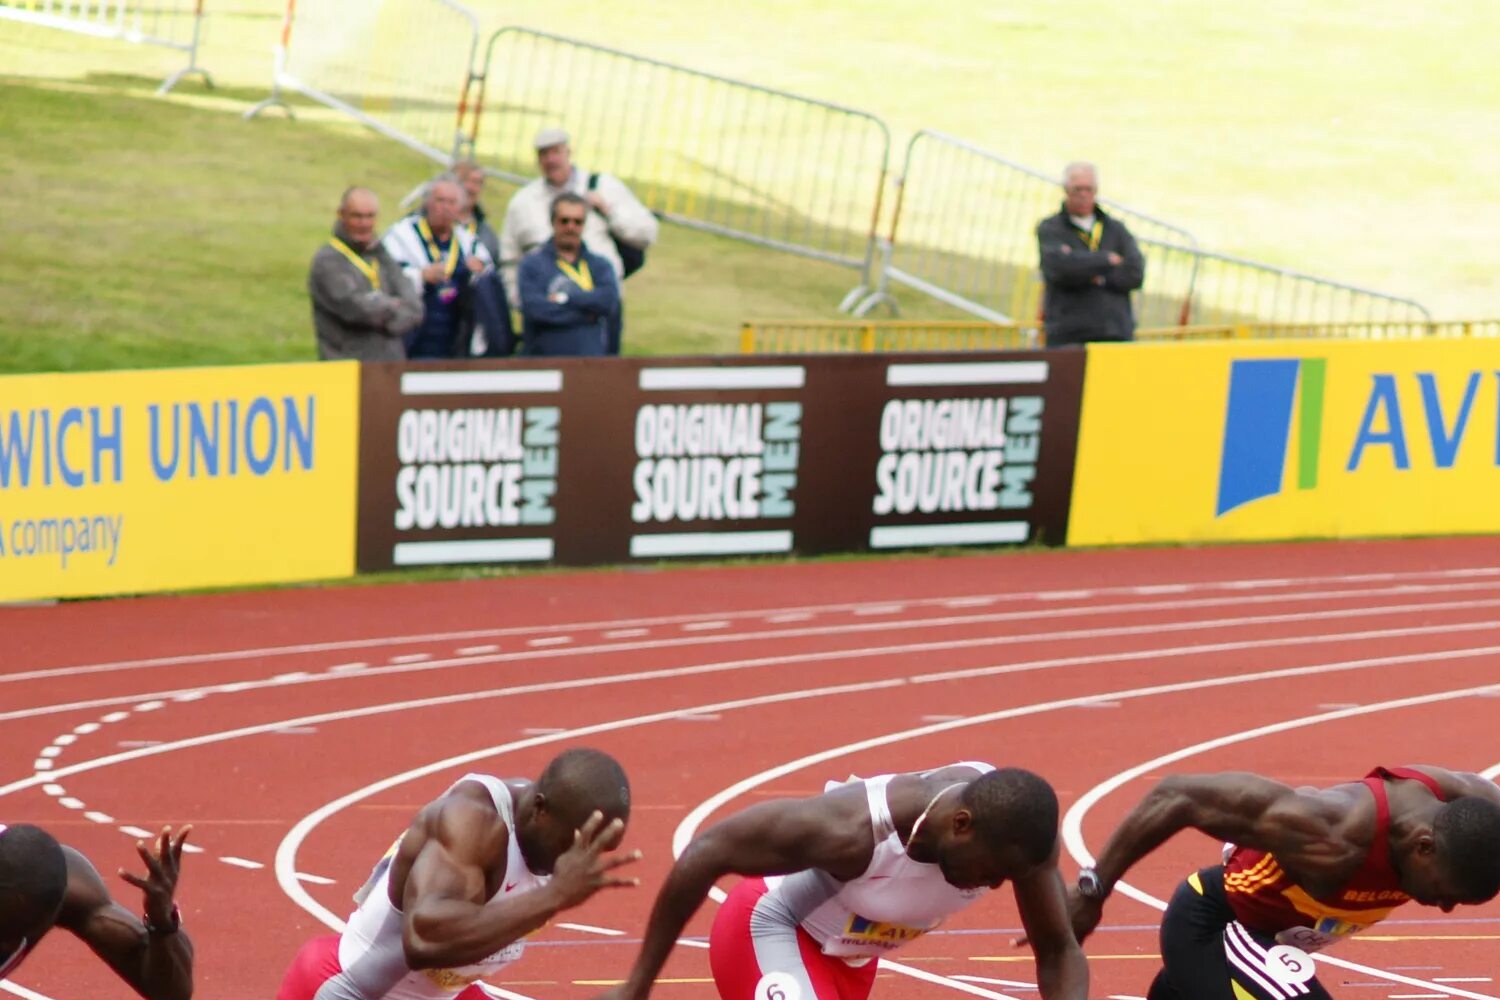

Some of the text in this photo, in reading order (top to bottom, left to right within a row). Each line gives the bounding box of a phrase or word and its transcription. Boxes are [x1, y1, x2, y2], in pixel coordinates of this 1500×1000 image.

[148, 396, 314, 481] UNION
[397, 408, 523, 463] ORIGINAL
[635, 402, 763, 458] ORIGINAL
[880, 397, 1008, 452] ORIGINAL
[998, 396, 1044, 509] MEN
[521, 406, 561, 525] MEN
[631, 456, 762, 523] SOURCE
[760, 401, 803, 517] MEN
[872, 449, 1002, 515] SOURCE
[394, 463, 522, 530] SOURCE
[11, 514, 122, 569] company
[1278, 952, 1302, 973] 5
